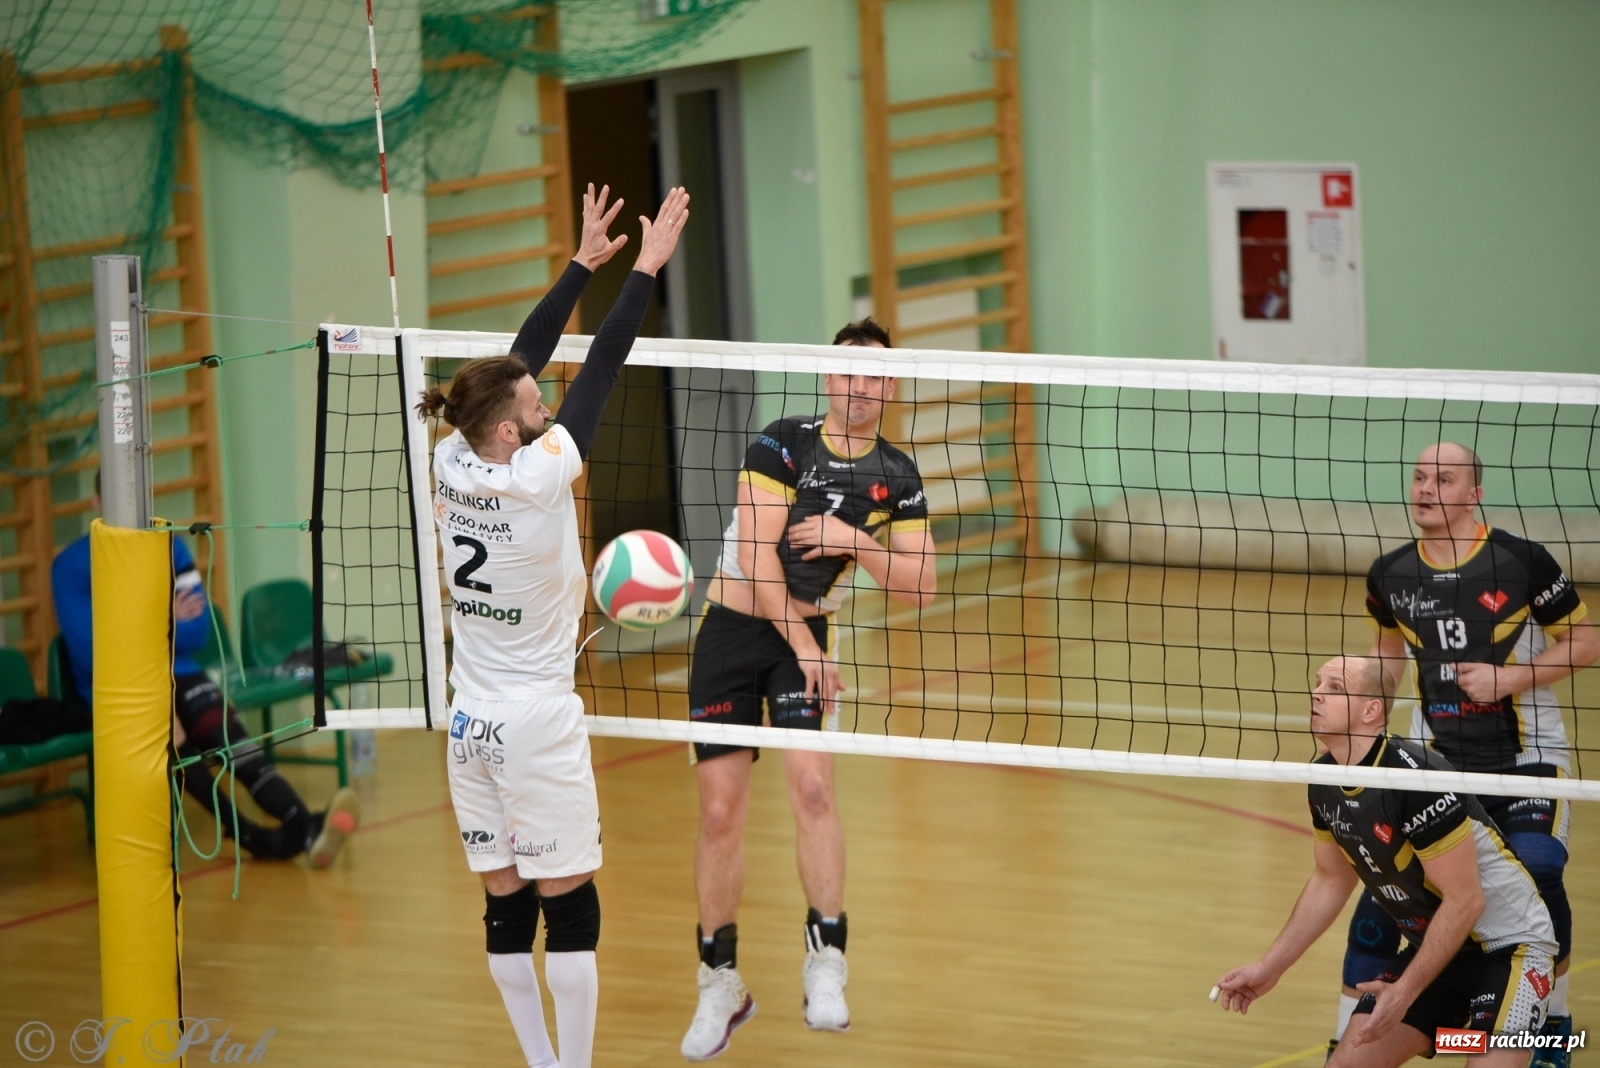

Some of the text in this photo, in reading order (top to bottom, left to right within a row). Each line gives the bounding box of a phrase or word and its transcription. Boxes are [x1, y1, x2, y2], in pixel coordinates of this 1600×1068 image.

[114, 334, 129, 342] 243
[826, 493, 845, 516] 7
[449, 511, 512, 533] ZOO-MAR
[452, 534, 493, 594] 2
[1436, 617, 1468, 650] 13
